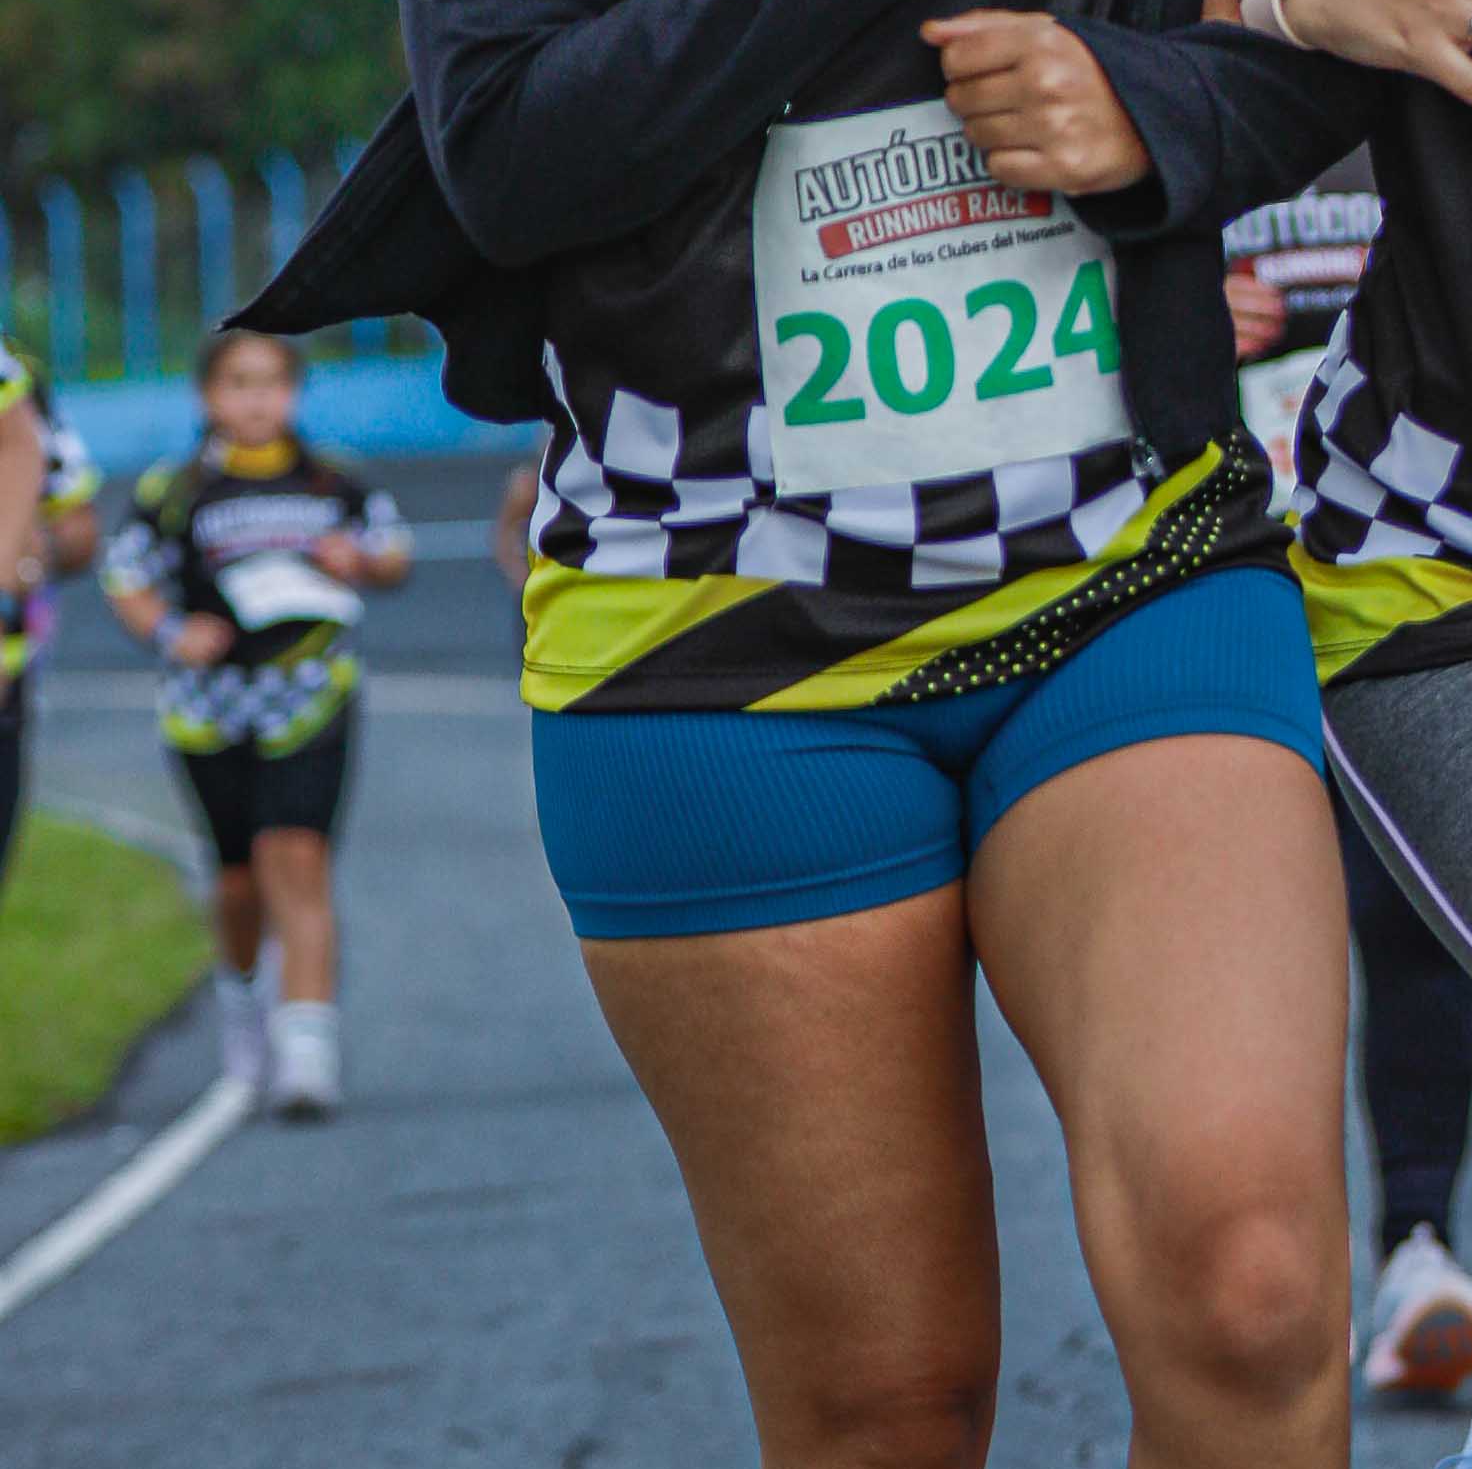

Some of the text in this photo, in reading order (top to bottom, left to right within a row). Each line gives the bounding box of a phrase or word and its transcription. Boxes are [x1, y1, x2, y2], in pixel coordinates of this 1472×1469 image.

[796, 129, 994, 222] AUTÓDR
[846, 186, 1030, 250] RUNNING RACE
[801, 266, 819, 283] La
[824, 260, 883, 280] Carrera
[887, 253, 907, 270] de
[912, 250, 934, 266] los
[938, 239, 989, 262] Clubes
[991, 234, 1014, 250] del
[775, 259, 1121, 427] 2024
